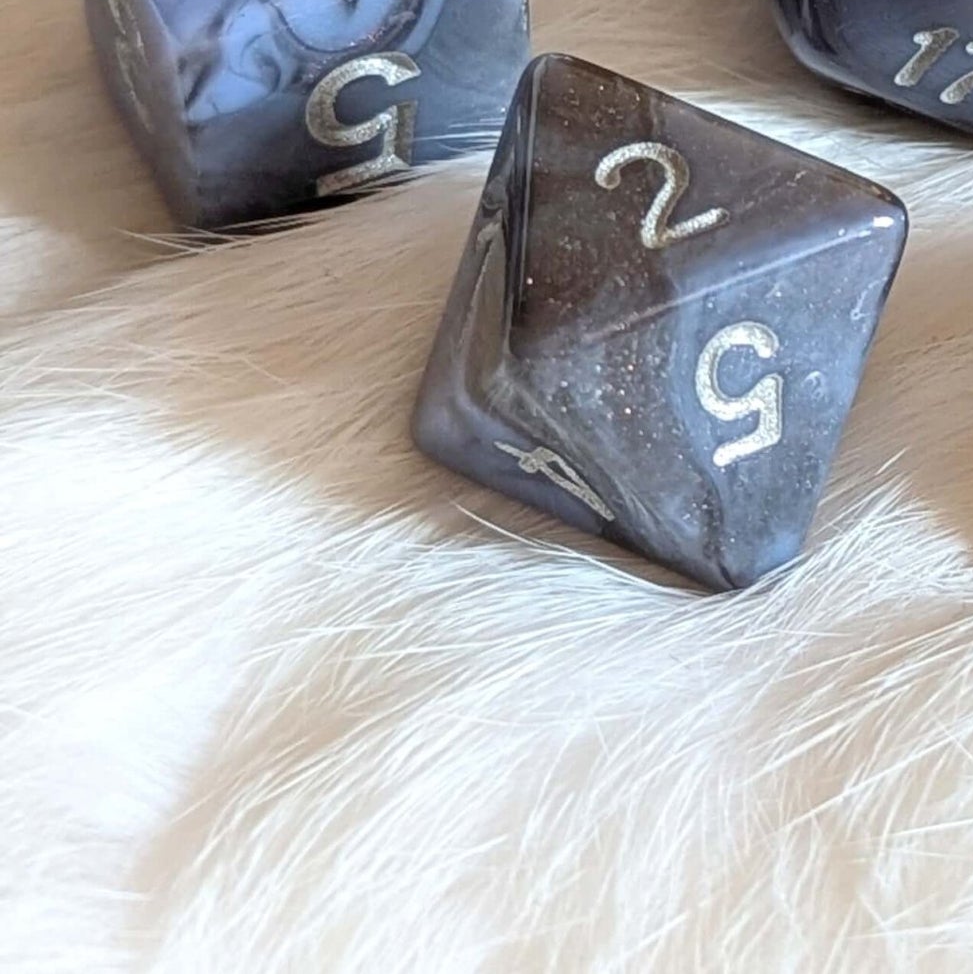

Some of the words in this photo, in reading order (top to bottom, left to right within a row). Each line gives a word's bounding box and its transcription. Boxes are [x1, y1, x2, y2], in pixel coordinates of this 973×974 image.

[305, 51, 421, 197] 5
[595, 141, 731, 248] 2
[695, 321, 784, 467] 5
